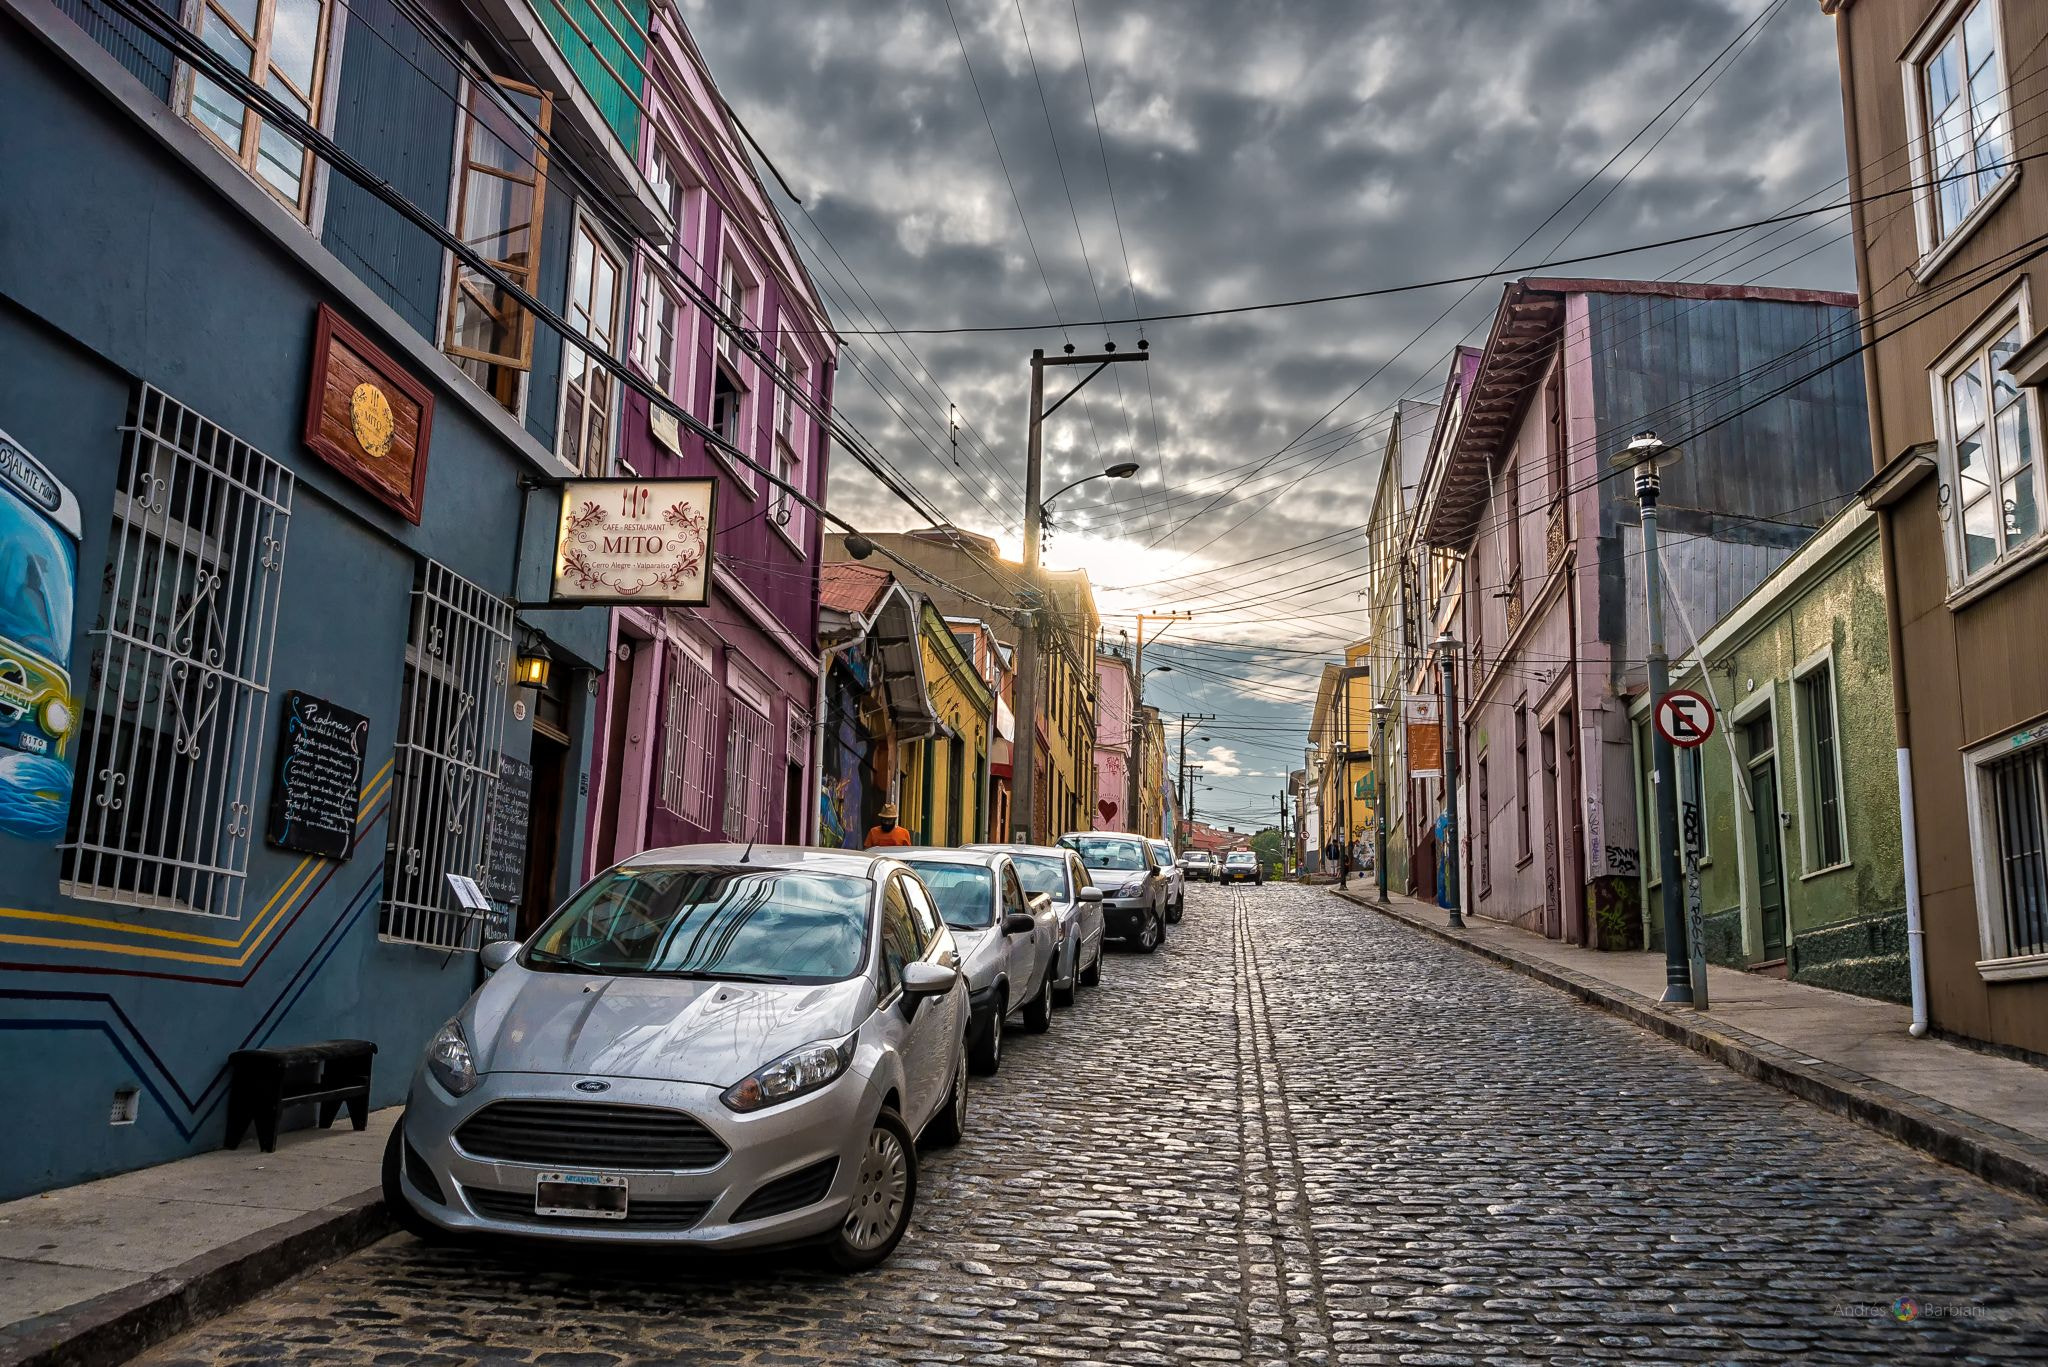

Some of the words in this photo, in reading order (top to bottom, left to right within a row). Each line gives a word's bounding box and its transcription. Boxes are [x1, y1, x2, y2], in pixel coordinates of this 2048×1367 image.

[602, 523, 620, 531] CAFE
[624, 523, 666, 531] RESTAURANT
[602, 536, 663, 554] MITO
[611, 562, 631, 570] Alegre
[304, 703, 352, 733] Piadinas
[1672, 700, 1699, 736] E
